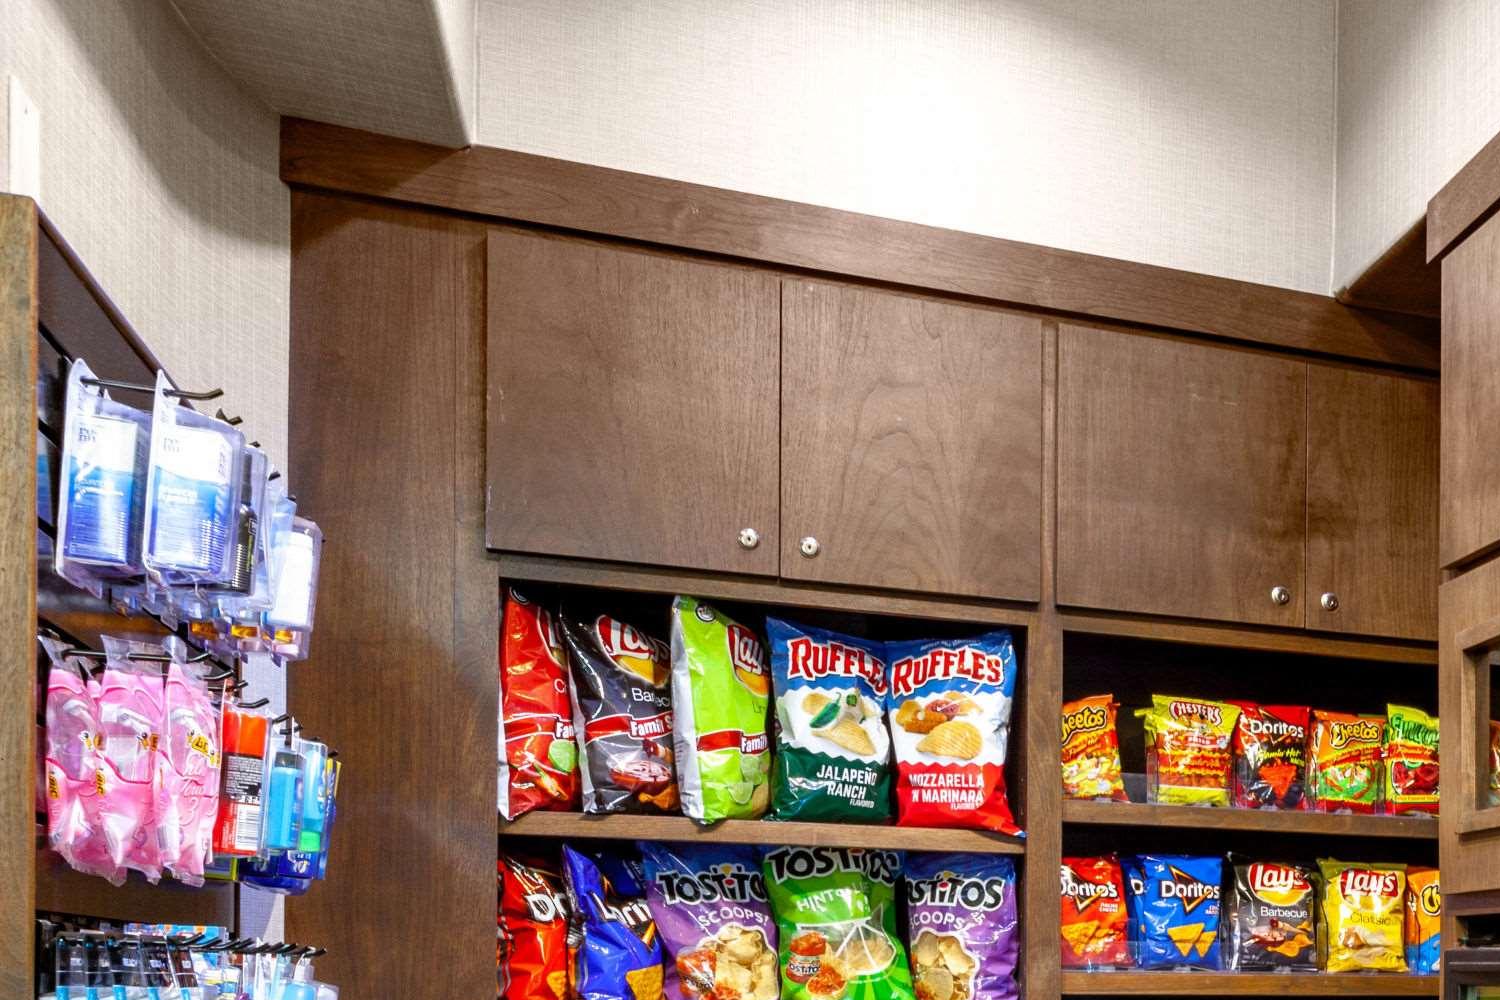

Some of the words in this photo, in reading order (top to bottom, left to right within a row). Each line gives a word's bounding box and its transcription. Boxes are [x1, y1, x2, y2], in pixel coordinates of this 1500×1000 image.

[892, 646, 1004, 698] RUFFLES
[1062, 708, 1106, 741] heetos
[1170, 701, 1222, 727] CHESTER'S
[1249, 720, 1304, 738] Doritos
[1331, 721, 1379, 747] Cheetos
[816, 765, 877, 786] JALAPEÑO
[909, 773, 984, 788] MOZZARELLA
[827, 782, 866, 799] RANCH
[921, 789, 984, 803] MARINARA
[657, 863, 768, 905] TOSTITO
[1161, 880, 1220, 899] Doritos
[1345, 870, 1396, 896] Lay's
[699, 907, 768, 928] SCOOPS!
[1261, 906, 1307, 919] Barbecue
